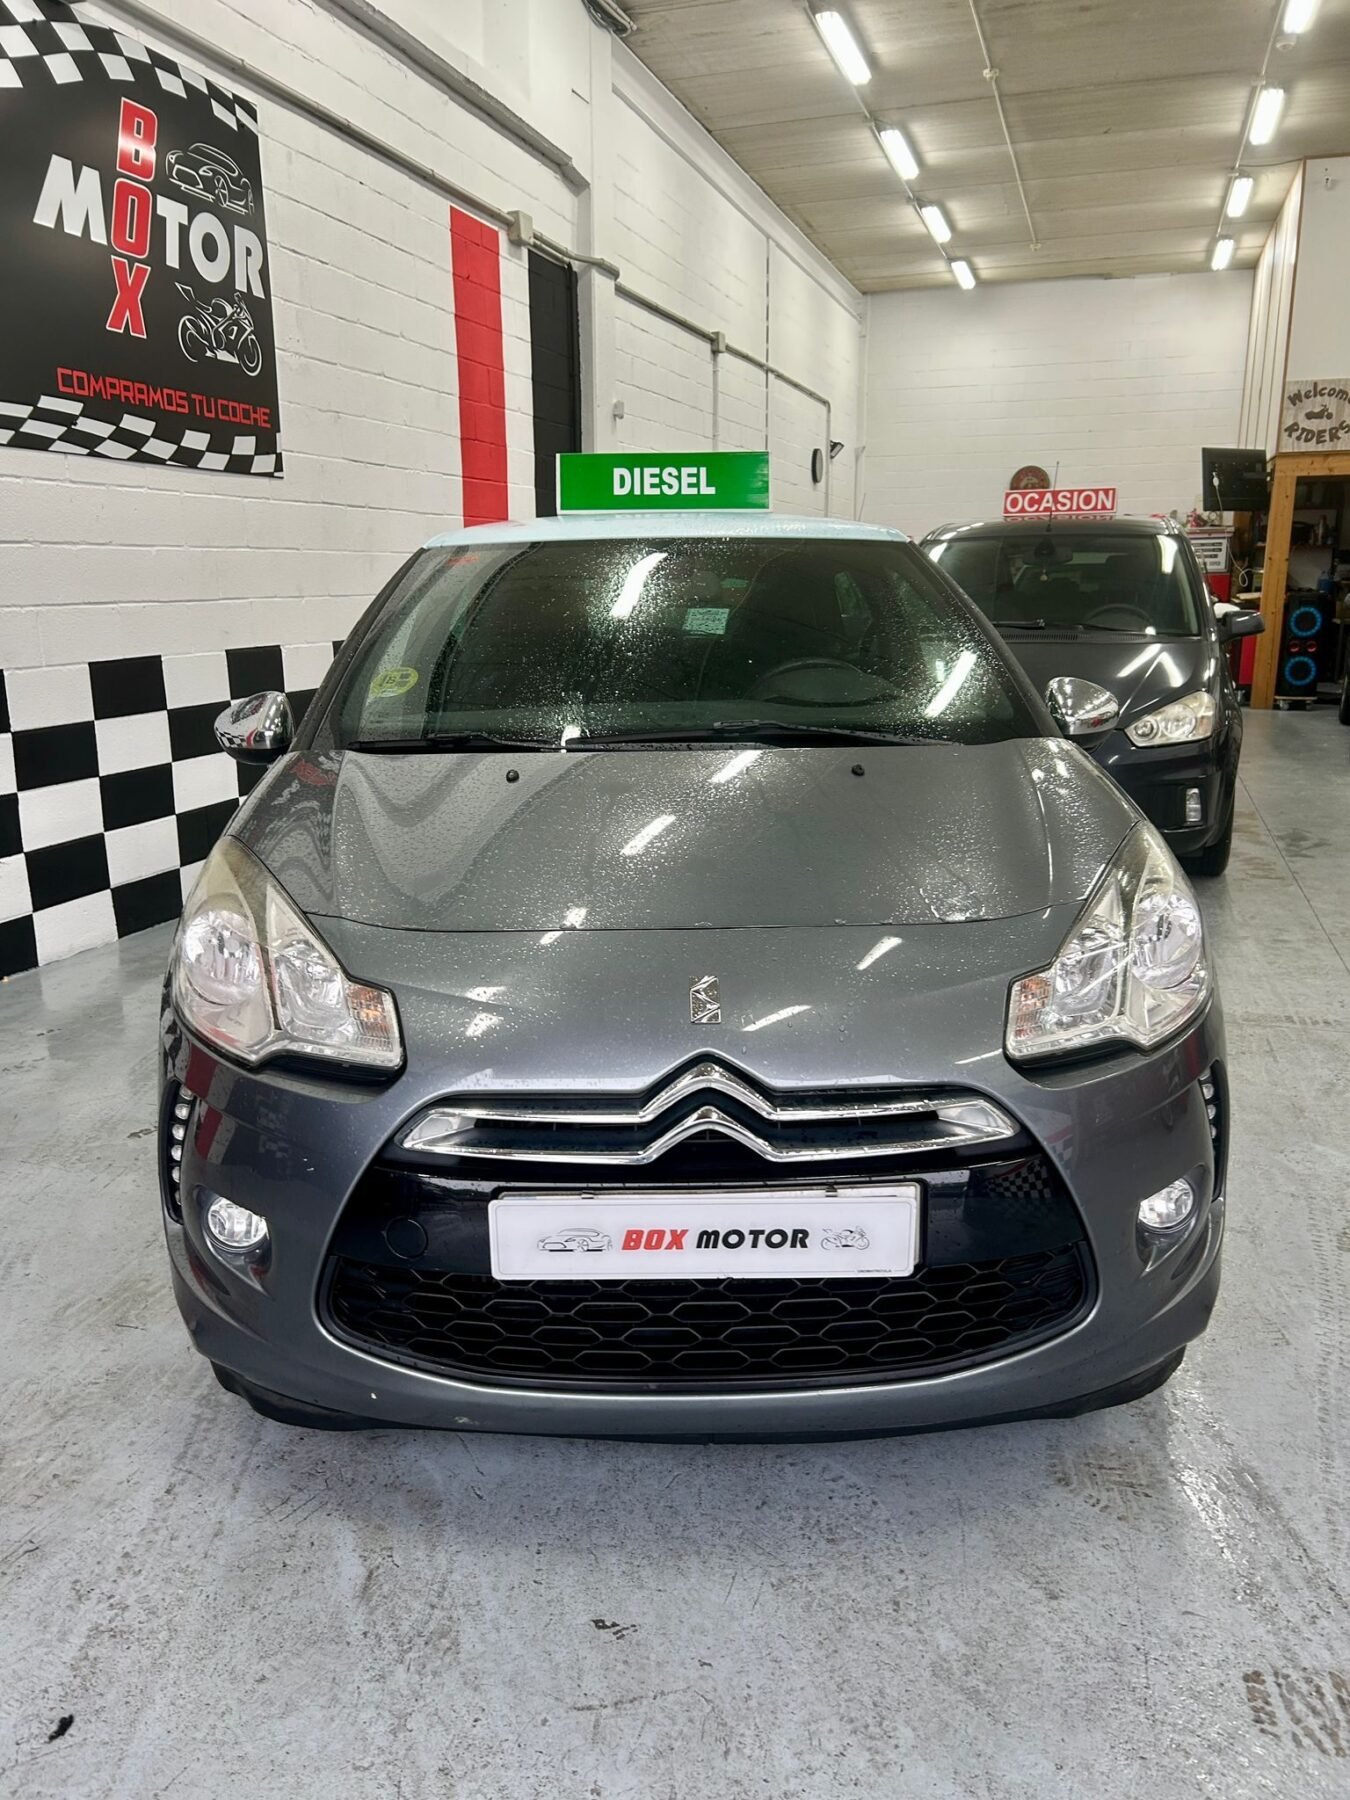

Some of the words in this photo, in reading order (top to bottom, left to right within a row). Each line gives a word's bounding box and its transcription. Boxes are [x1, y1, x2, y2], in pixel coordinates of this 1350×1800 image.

[33, 153, 265, 299] MOTOR
[106, 96, 158, 339] BOX
[57, 367, 189, 414] COMPRAMOS
[191, 393, 215, 418] TU
[218, 399, 272, 429] COCHE
[1287, 382, 1350, 407] Welcom
[1284, 420, 1350, 445] RIDERS
[613, 467, 716, 495] DIESEL
[1006, 490, 1114, 513] OCASION
[622, 1229, 689, 1251] BOX
[696, 1229, 810, 1250] MOTOR
